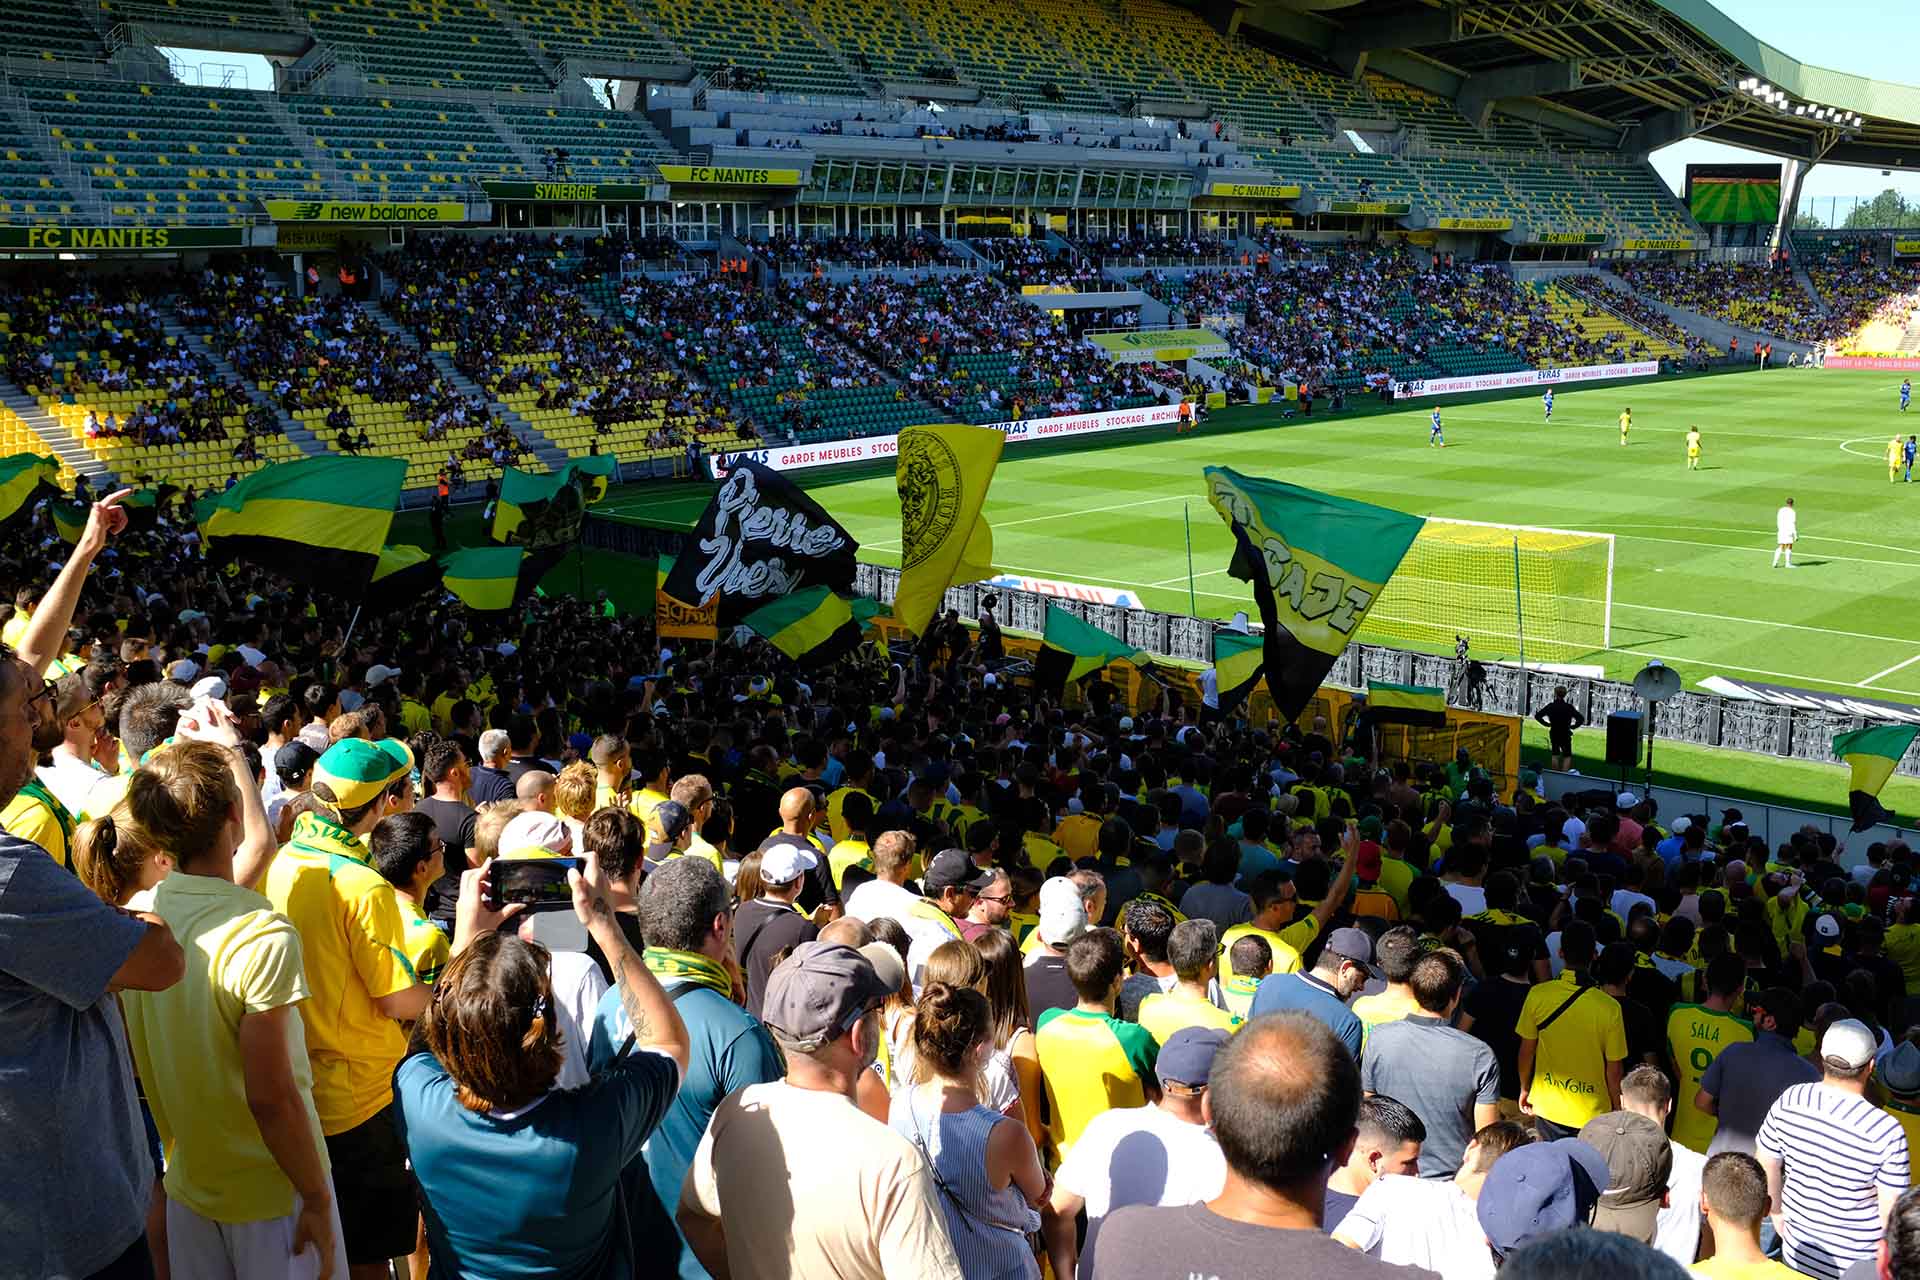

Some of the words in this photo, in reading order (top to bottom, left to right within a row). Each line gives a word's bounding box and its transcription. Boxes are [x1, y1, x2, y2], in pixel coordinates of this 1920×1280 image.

[690, 168, 709, 181] FC
[713, 169, 769, 183] NANTES
[535, 184, 597, 200] SYNERGIE
[1232, 185, 1246, 196] FC
[1247, 185, 1281, 197] NANTES
[330, 206, 366, 220] new
[369, 204, 438, 220] balance
[28, 228, 62, 249] FC
[71, 228, 169, 248] NANTES
[1647, 240, 1681, 249] NANTES
[1537, 369, 1561, 380] EVRAS
[1037, 422, 1063, 435] GARDE
[1066, 419, 1100, 431] MEUBLES
[1106, 414, 1145, 426] STOCKAGE
[781, 451, 816, 466] GARDE
[818, 446, 863, 461] MEUBLES
[1690, 1021, 1720, 1042] SALA
